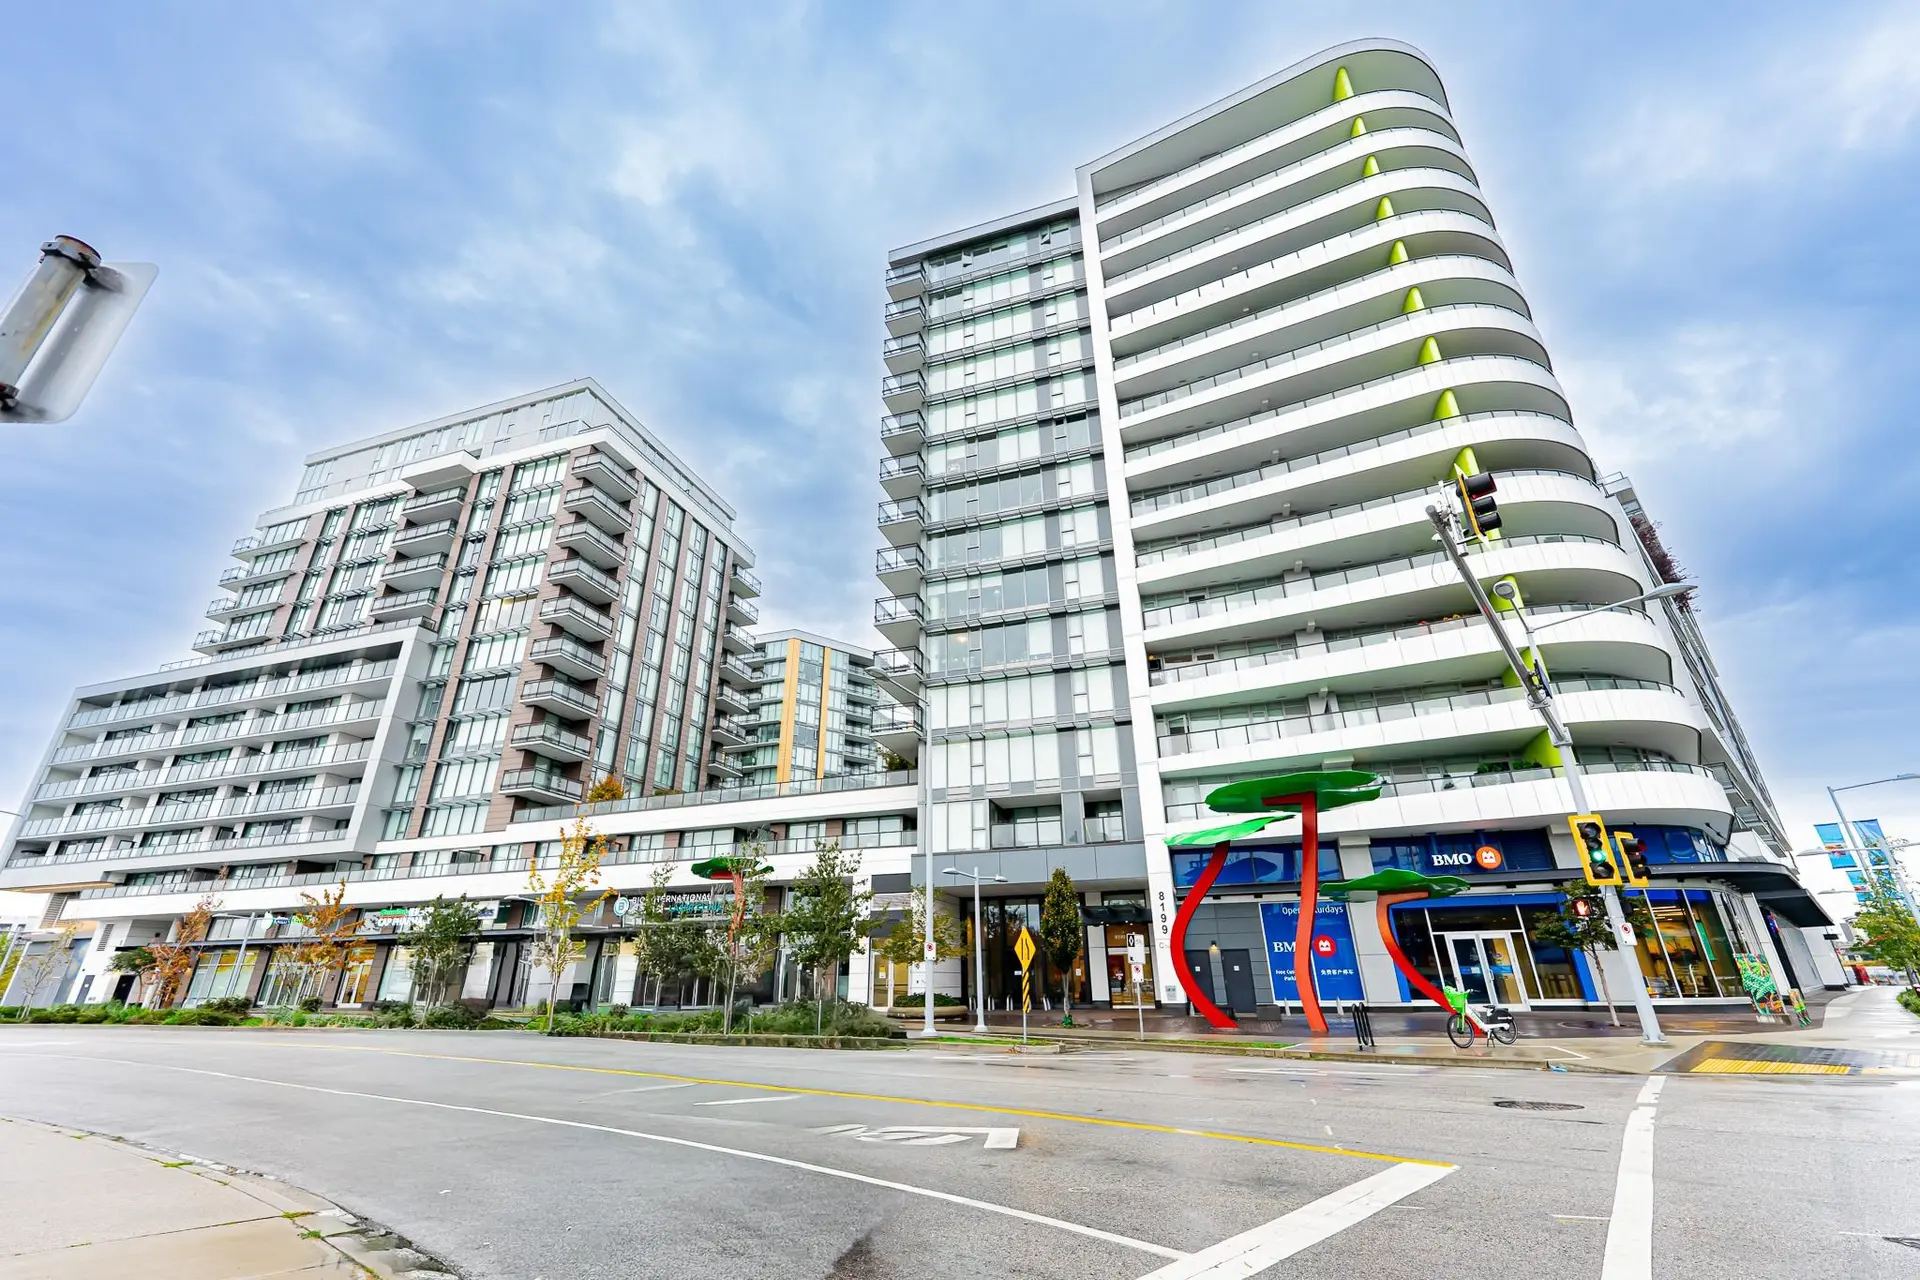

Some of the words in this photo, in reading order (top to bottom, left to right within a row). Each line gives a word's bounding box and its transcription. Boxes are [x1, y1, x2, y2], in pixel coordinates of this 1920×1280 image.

[1431, 853, 1473, 866] BMO
[1158, 891, 1168, 934] 8199
[1272, 941, 1296, 952] BM
